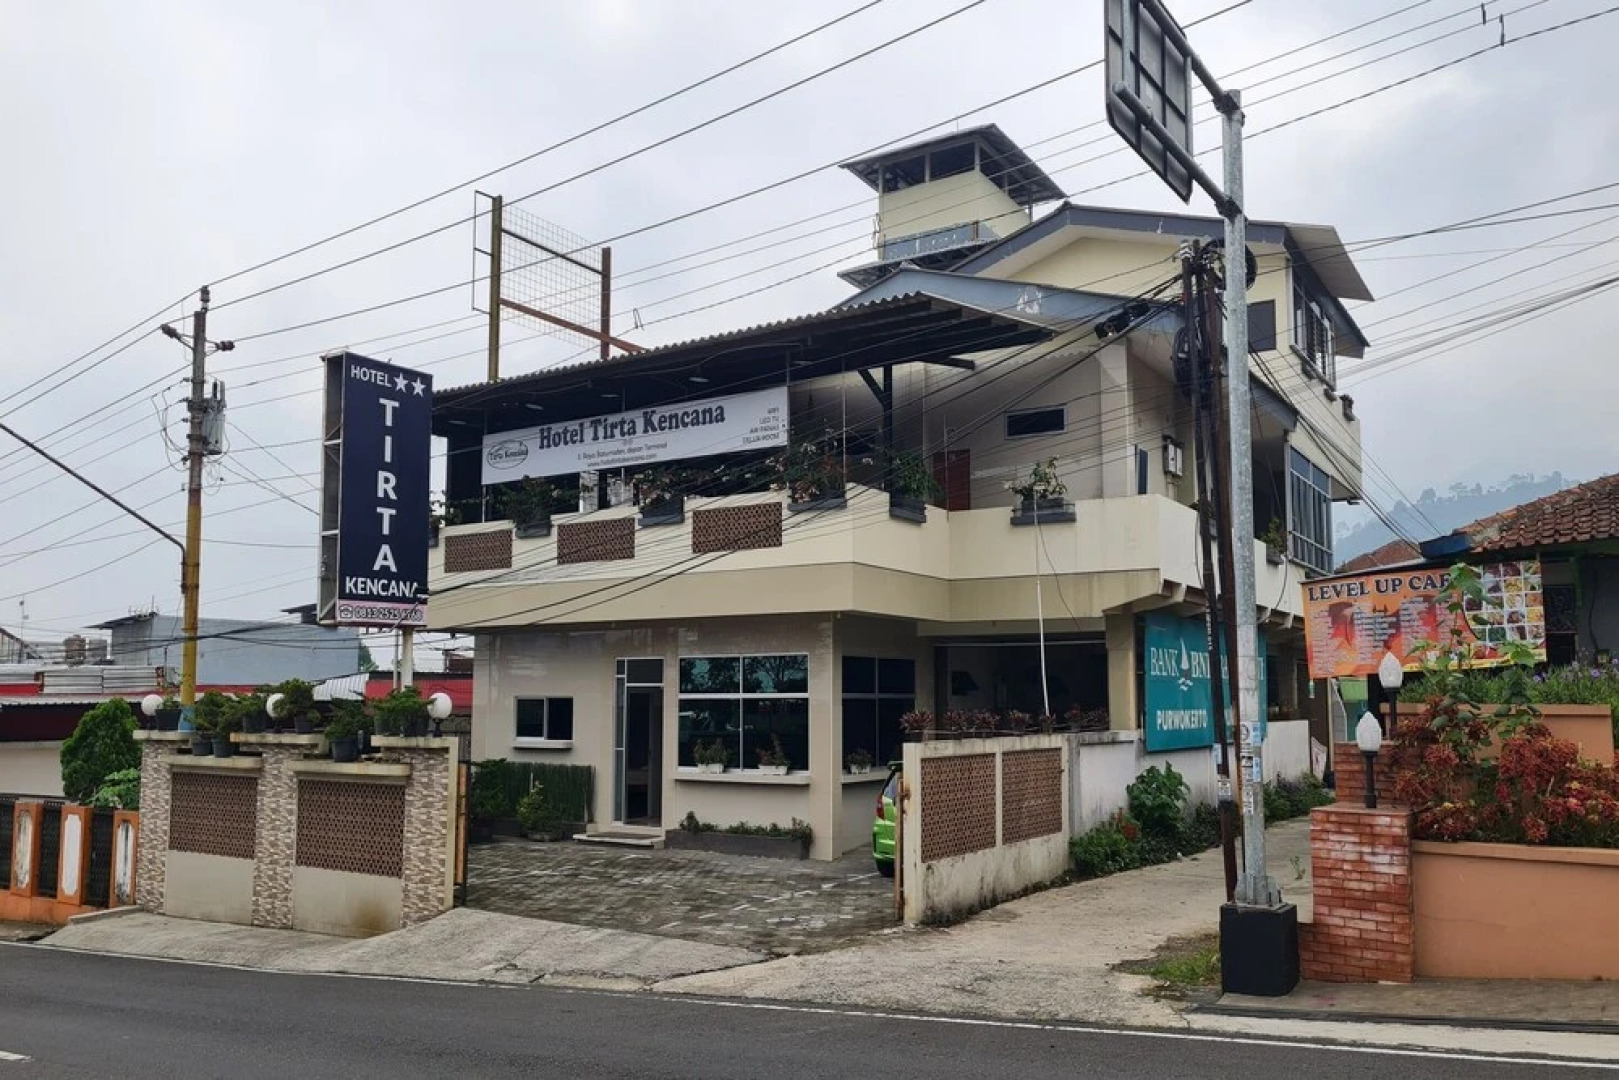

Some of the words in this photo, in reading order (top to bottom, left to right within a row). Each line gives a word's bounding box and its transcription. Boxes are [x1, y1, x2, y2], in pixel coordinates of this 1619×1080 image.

[351, 364, 392, 388] HOTEL
[539, 422, 585, 450] Hotel
[590, 417, 637, 442] Tirta
[642, 405, 726, 434] Kencana
[373, 398, 399, 573] TIRTA
[1308, 581, 1370, 602] LEVEL
[1375, 578, 1403, 594] UP
[1408, 572, 1452, 591] CAF
[1150, 647, 1180, 677] BANK
[1190, 651, 1211, 679] BNI
[1156, 708, 1208, 731] PURWOKERTO
